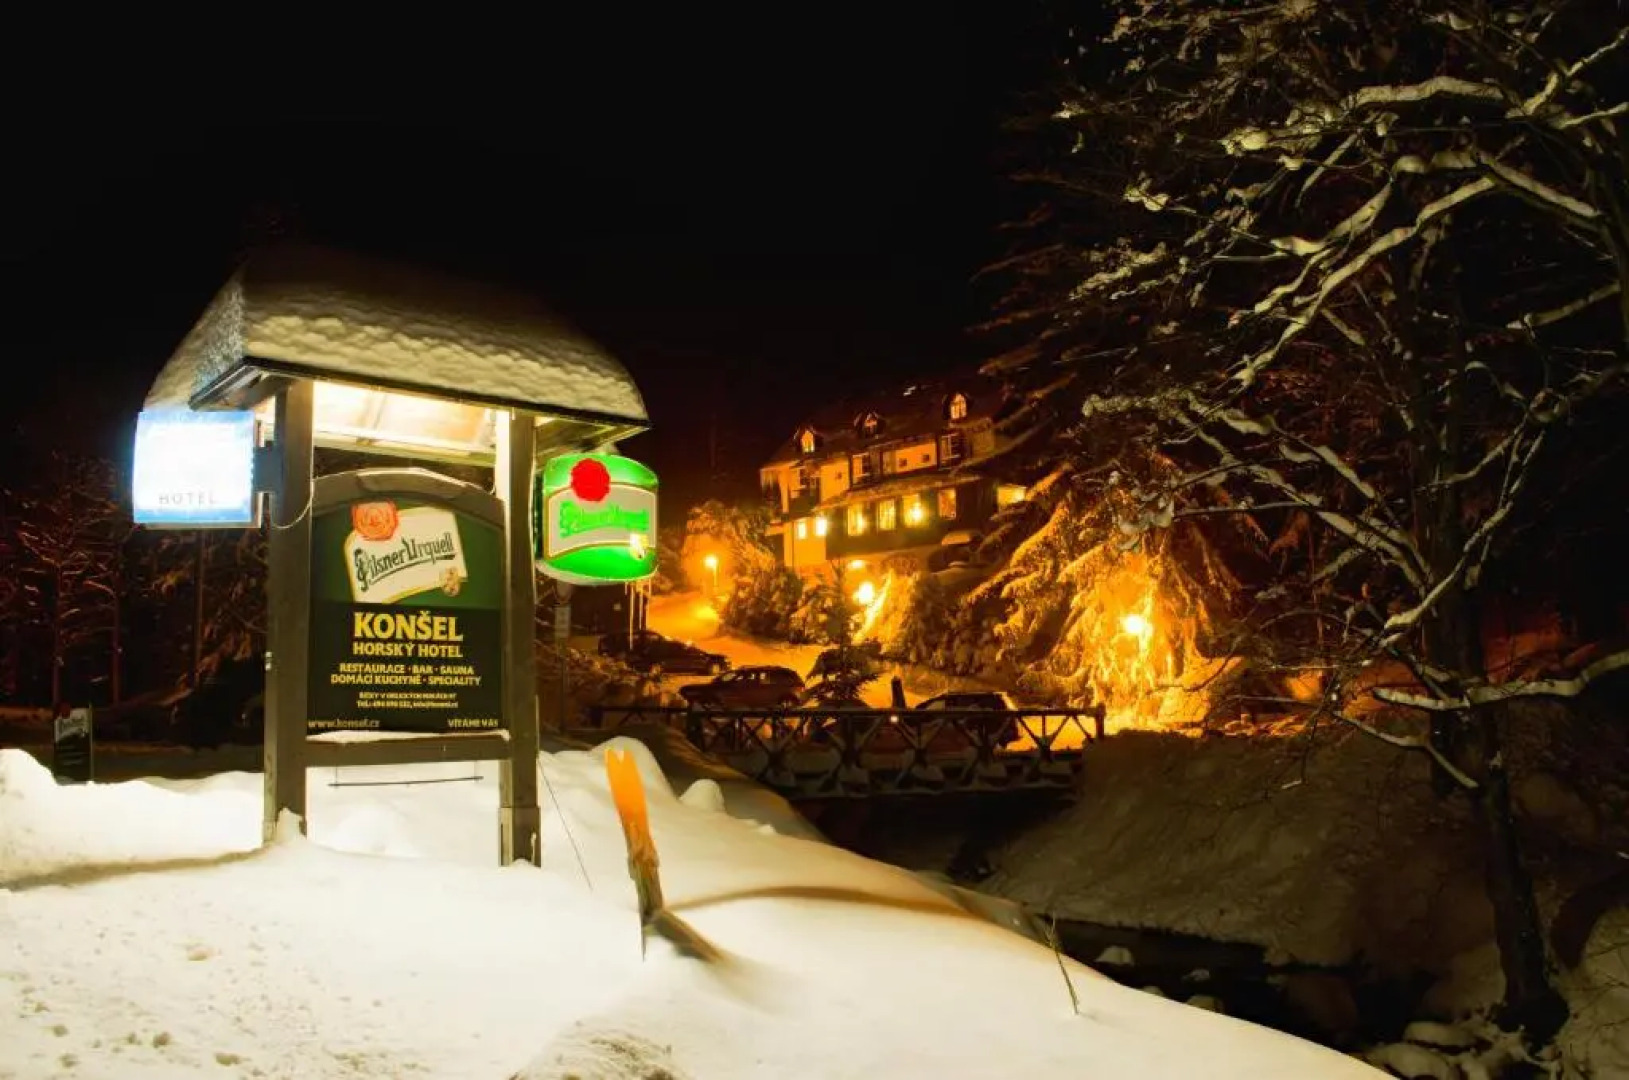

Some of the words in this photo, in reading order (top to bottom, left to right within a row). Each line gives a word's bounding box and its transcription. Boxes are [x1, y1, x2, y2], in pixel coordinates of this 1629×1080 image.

[158, 492, 216, 504] HOTEL
[354, 548, 409, 592] Pilsner
[401, 532, 454, 564] Urquell
[353, 610, 464, 642] KONŠEL
[352, 641, 417, 656] HORSKÝ
[418, 645, 464, 658] HOTEL
[338, 662, 405, 674] RESTAURACE
[411, 664, 434, 675] BAR
[440, 665, 475, 675] SAUNA
[428, 675, 482, 686] SPECIALITY
